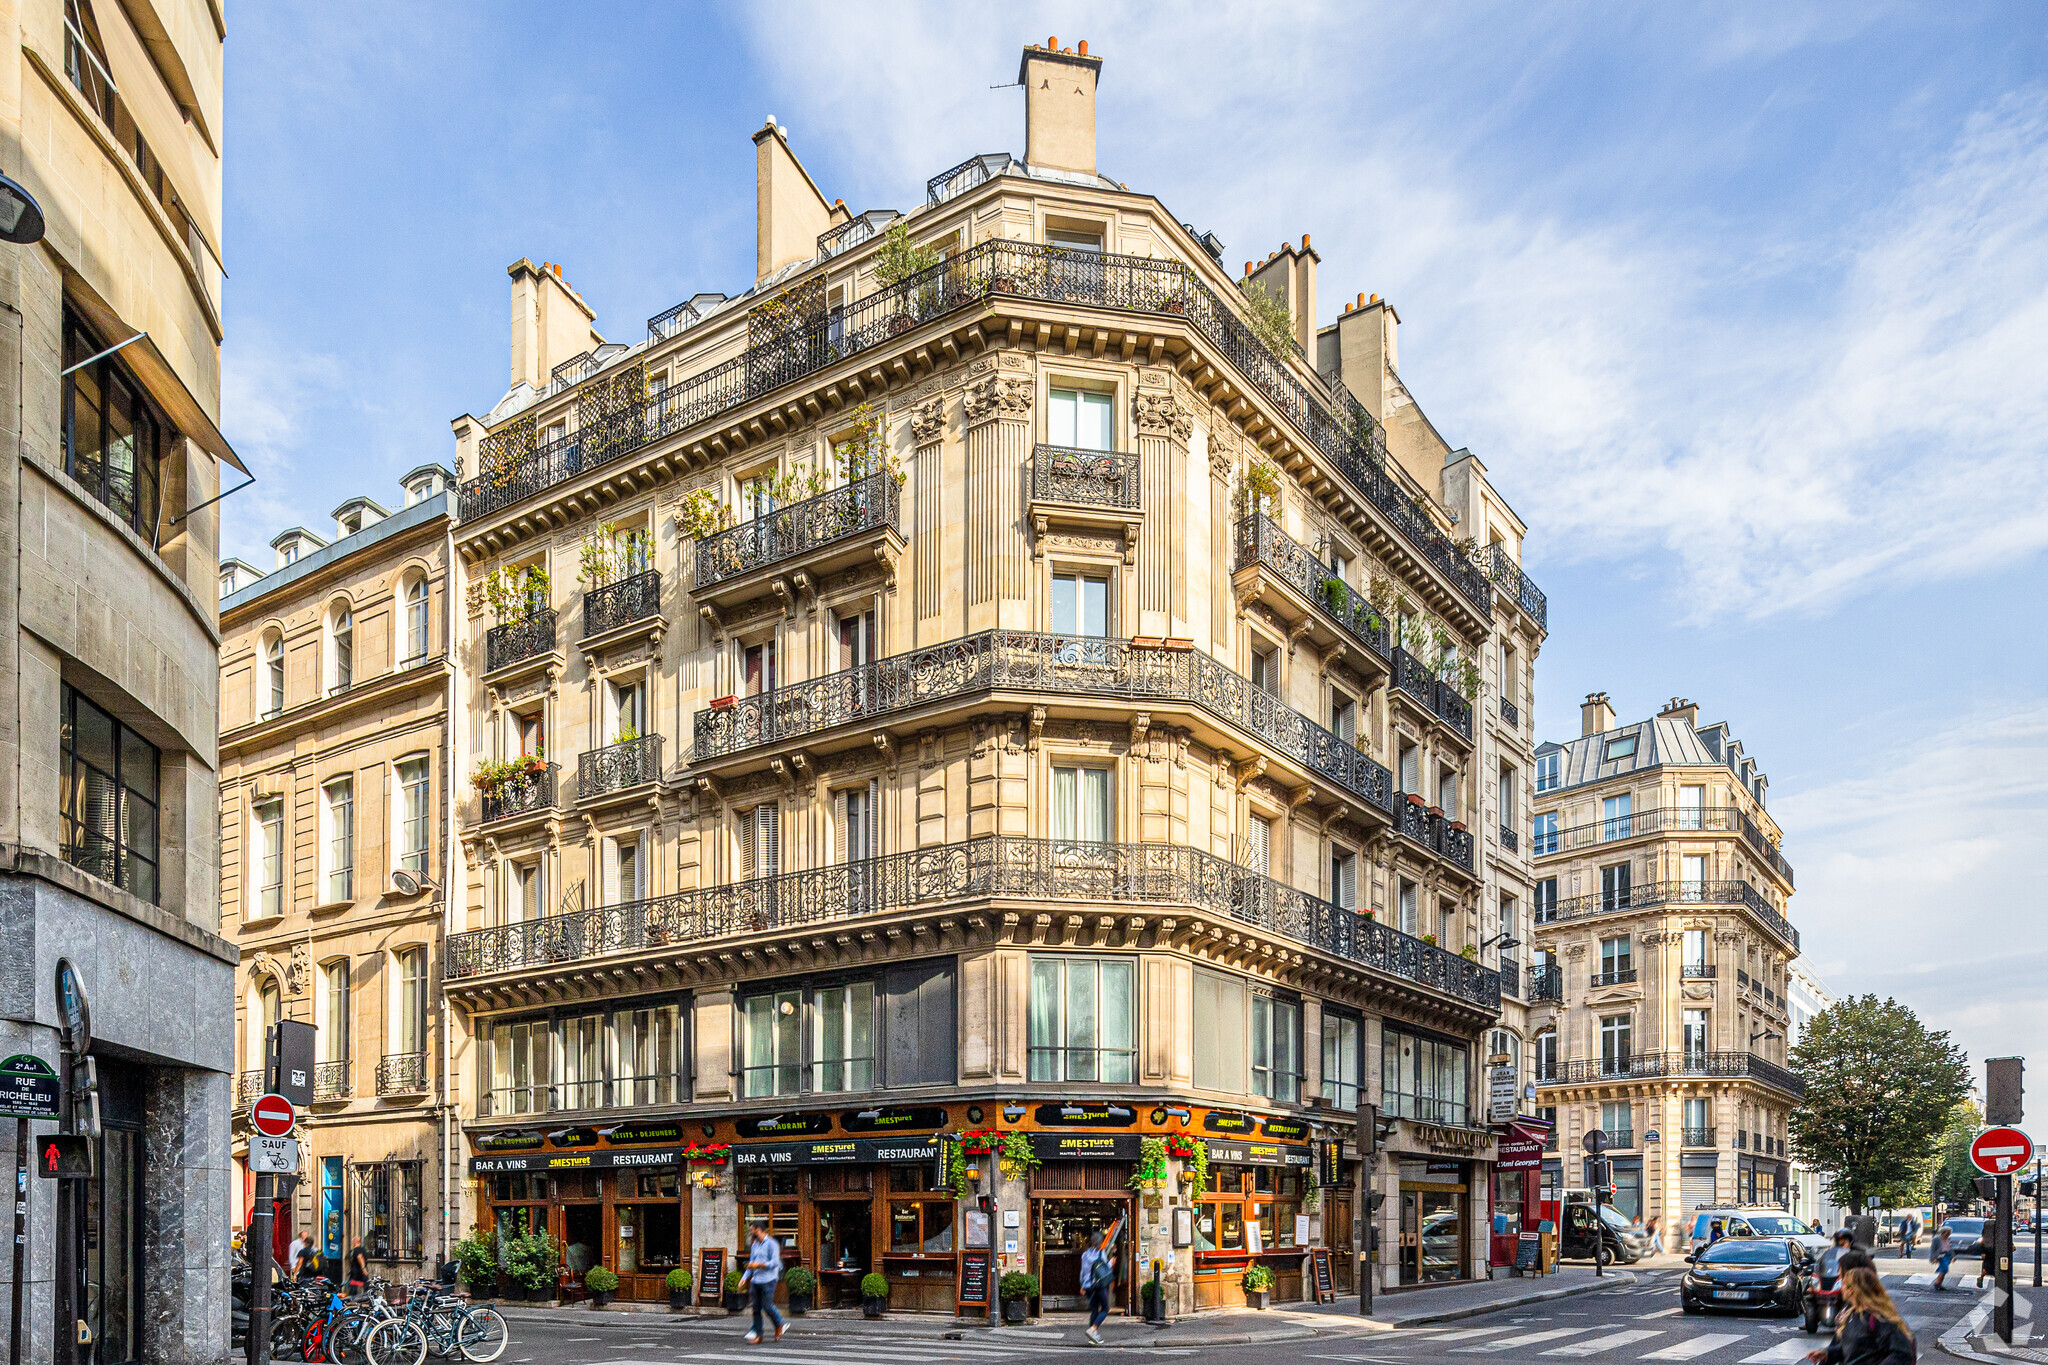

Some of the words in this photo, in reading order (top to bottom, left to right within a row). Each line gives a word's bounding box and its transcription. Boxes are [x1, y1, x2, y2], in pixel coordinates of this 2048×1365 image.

[15, 1077, 36, 1087] RUE
[0, 1091, 52, 1103] RICHELIEU
[1268, 1124, 1300, 1134] RESTAURANT
[567, 1134, 581, 1142] BAR
[1419, 1126, 1446, 1141] JEAN
[1451, 1130, 1493, 1148] VINCHON
[261, 1139, 287, 1150] SAUF
[613, 1153, 674, 1165] RESTAURANT
[737, 1154, 757, 1164] BAR
[760, 1154, 768, 1163] A
[770, 1152, 792, 1162] VINS
[877, 1148, 937, 1159] RESTAURAN
[1211, 1149, 1224, 1160] BAR
[1224, 1150, 1231, 1160] A
[1230, 1151, 1243, 1161] VINS
[475, 1161, 494, 1170] BAR
[496, 1161, 504, 1170] A
[506, 1160, 527, 1169] VINS
[1284, 1154, 1311, 1165] RESTAURANT
